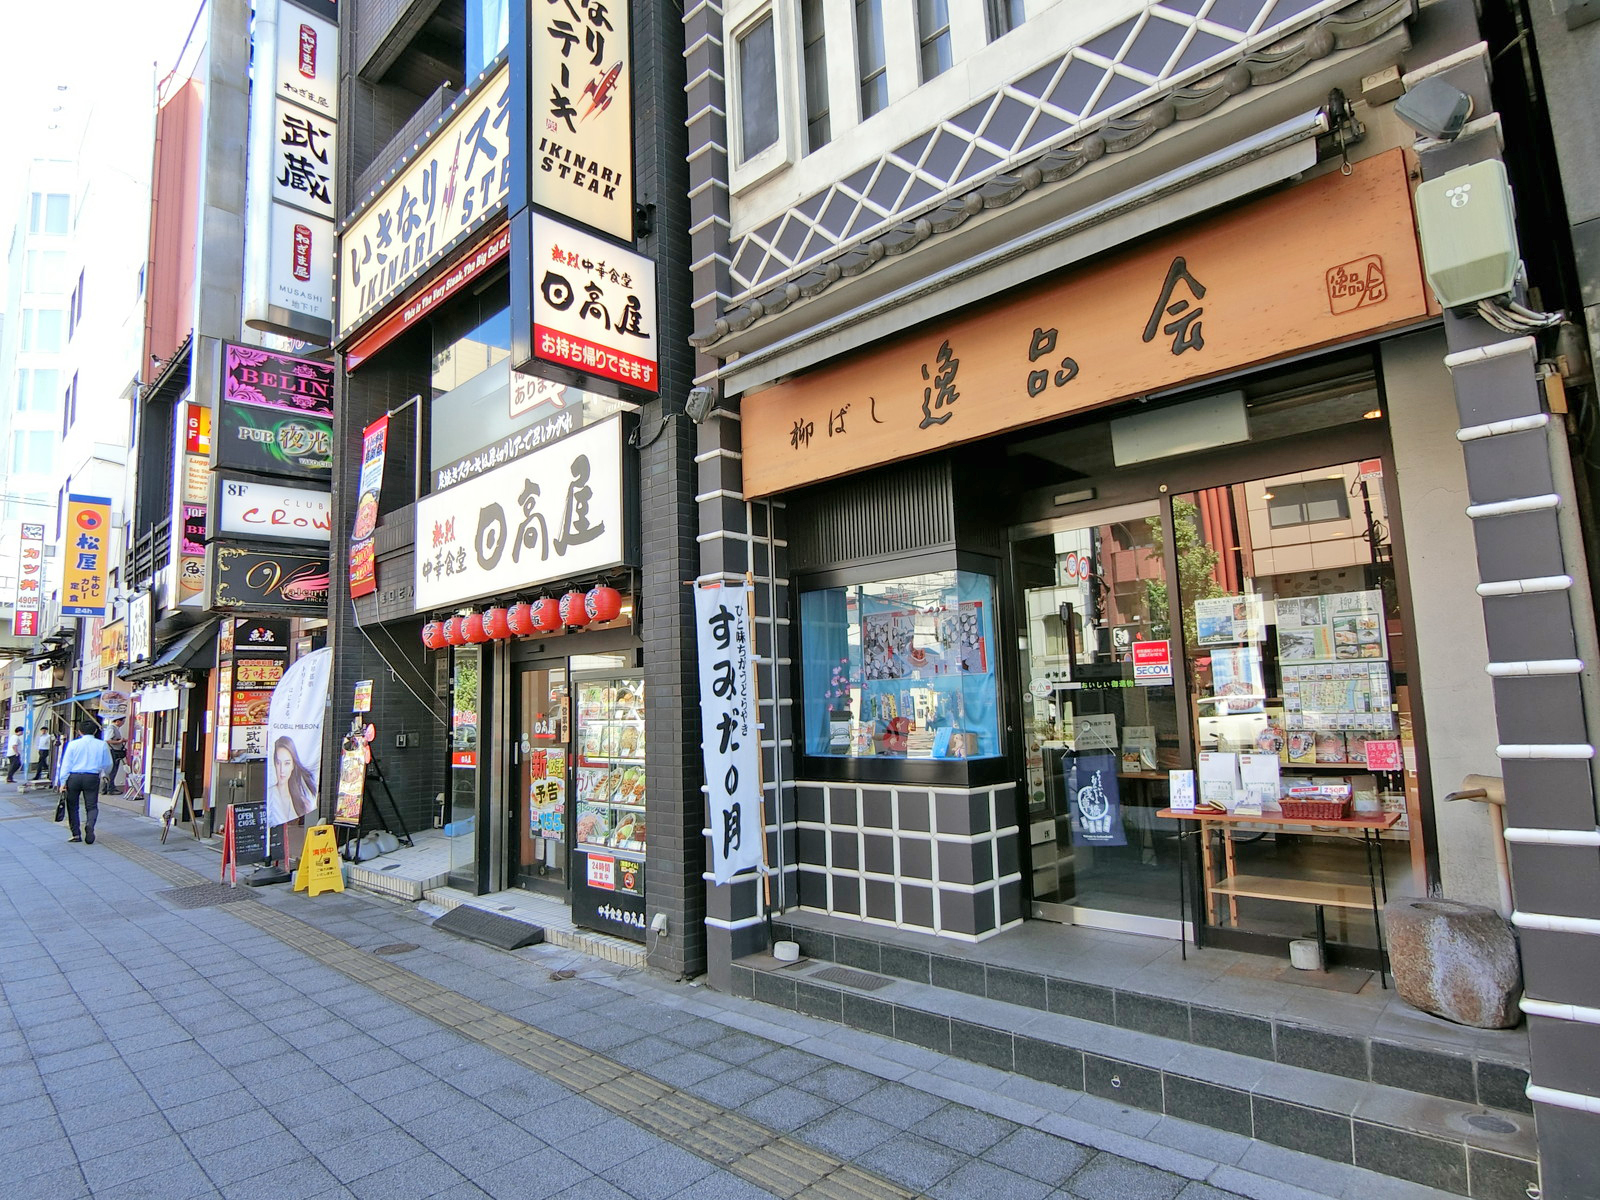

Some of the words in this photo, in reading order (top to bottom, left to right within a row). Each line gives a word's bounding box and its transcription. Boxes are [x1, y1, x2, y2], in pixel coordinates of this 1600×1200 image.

[277, 113, 332, 204] 武蔵
[539, 137, 622, 187] IKINARI
[541, 156, 616, 201] STEAK
[351, 159, 438, 288] いきなり
[358, 223, 436, 315] IKINARI
[403, 308, 417, 323] This
[421, 296, 433, 312] The
[432, 287, 446, 304] Very
[463, 260, 476, 277] The
[475, 251, 488, 270] Big
[487, 242, 500, 260] Cut
[279, 284, 323, 303] MUSASHI
[540, 270, 651, 340] 日高屋
[542, 333, 653, 383] お持ち帰りできます
[240, 367, 335, 399] BELIN
[238, 426, 274, 443] PUB
[790, 396, 885, 450] 柳ばし
[228, 484, 248, 497] 8F
[284, 499, 323, 510] CLUB
[475, 454, 605, 571] 日高屋
[433, 515, 455, 548] 熱烈
[76, 532, 100, 571] 松屋
[422, 546, 467, 583] 中華食堂
[20, 548, 41, 592] カツ丼
[91, 575, 101, 598] 牛めし
[69, 582, 80, 603] 定食
[81, 578, 90, 600] カレー
[20, 611, 33, 635] お弁当
[1136, 665, 1169, 675] SECOM
[273, 722, 294, 730] GLOBAL
[708, 604, 741, 859] すみだの月
[532, 750, 548, 780] 新
[536, 781, 558, 804] 予告
[591, 861, 611, 873] 24時間
